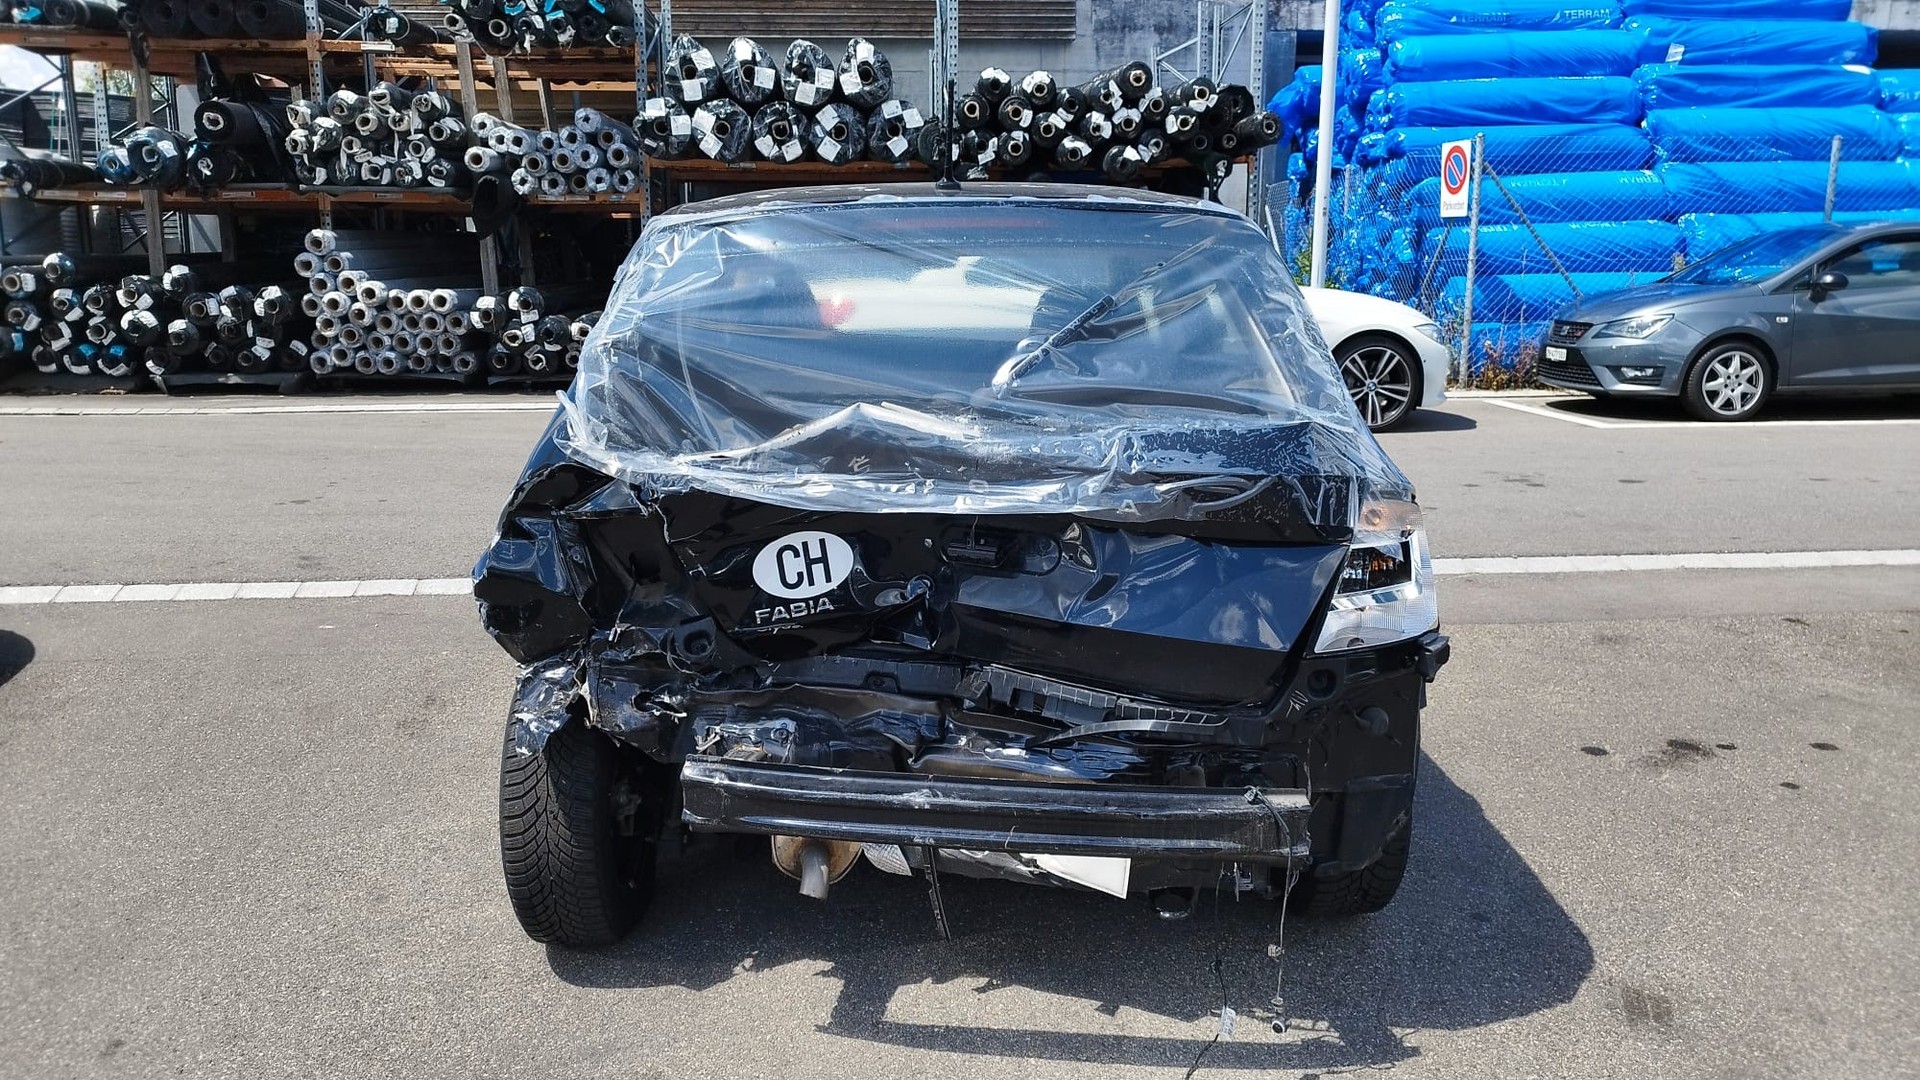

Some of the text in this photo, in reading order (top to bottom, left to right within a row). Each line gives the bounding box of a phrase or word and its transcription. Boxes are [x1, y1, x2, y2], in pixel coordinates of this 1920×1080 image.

[1564, 9, 1610, 19] TERRAM
[776, 538, 832, 590] CH
[755, 597, 835, 624] FABIA
